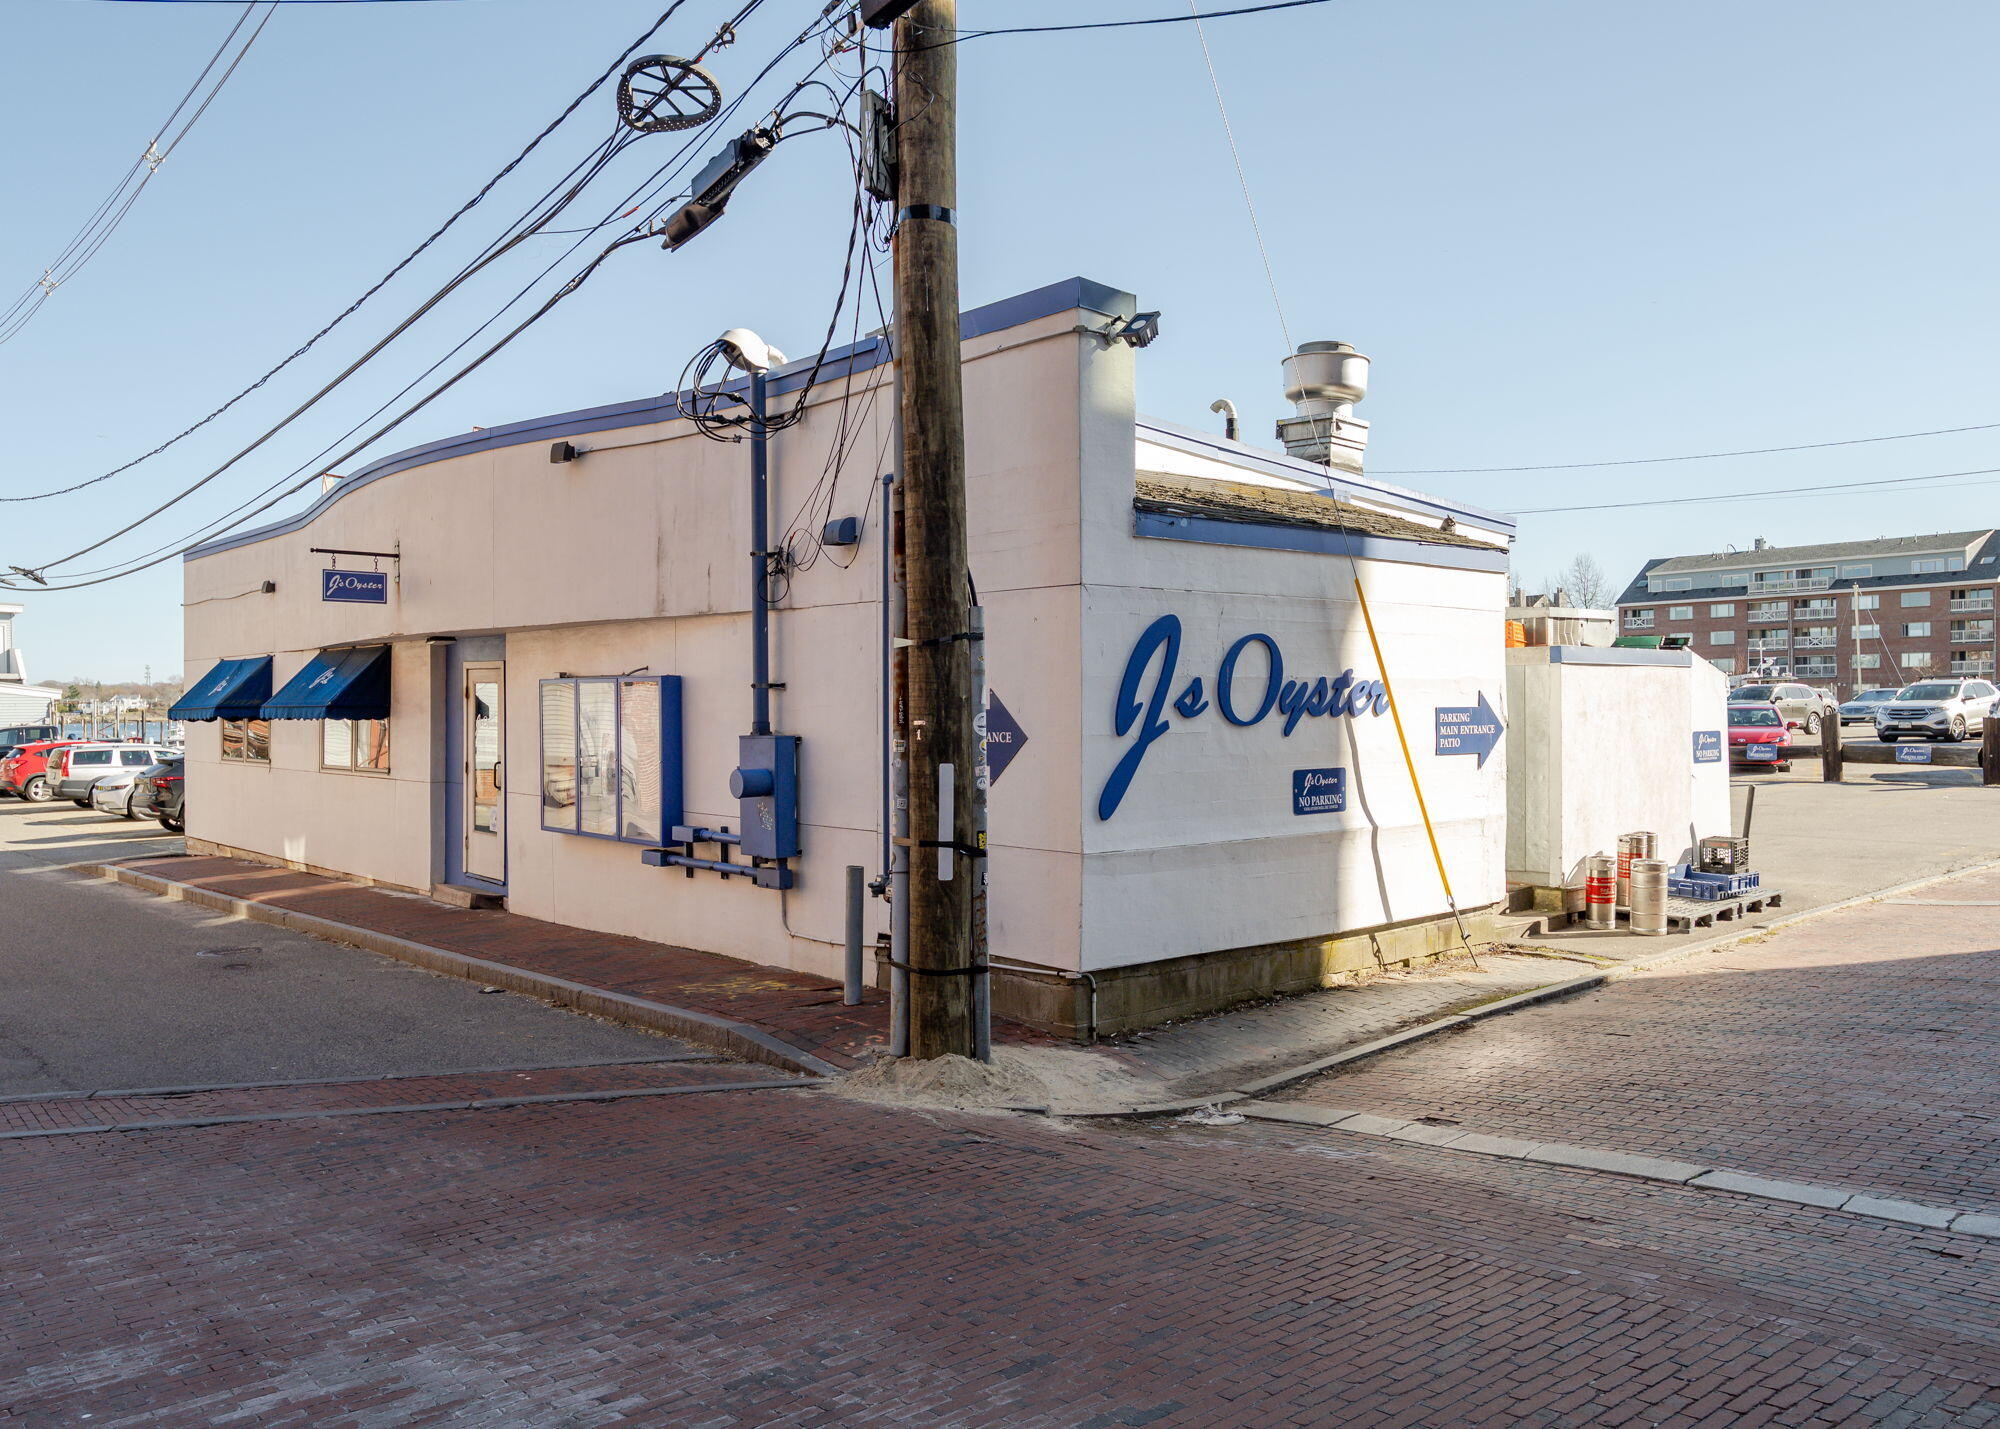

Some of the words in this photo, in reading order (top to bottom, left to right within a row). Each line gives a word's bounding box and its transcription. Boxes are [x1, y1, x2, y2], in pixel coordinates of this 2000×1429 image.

[346, 577, 383, 589] Oyster
[1217, 633, 1391, 737] Oyster
[1440, 713, 1470, 722] PARKING
[1440, 726, 1459, 735] MAIN
[1460, 725, 1496, 734] ENTRANCE
[1440, 738, 1461, 748] PATIO
[1315, 774, 1338, 786] Oyster
[1299, 796, 1311, 807] NO
[1312, 794, 1342, 805] PARKING
